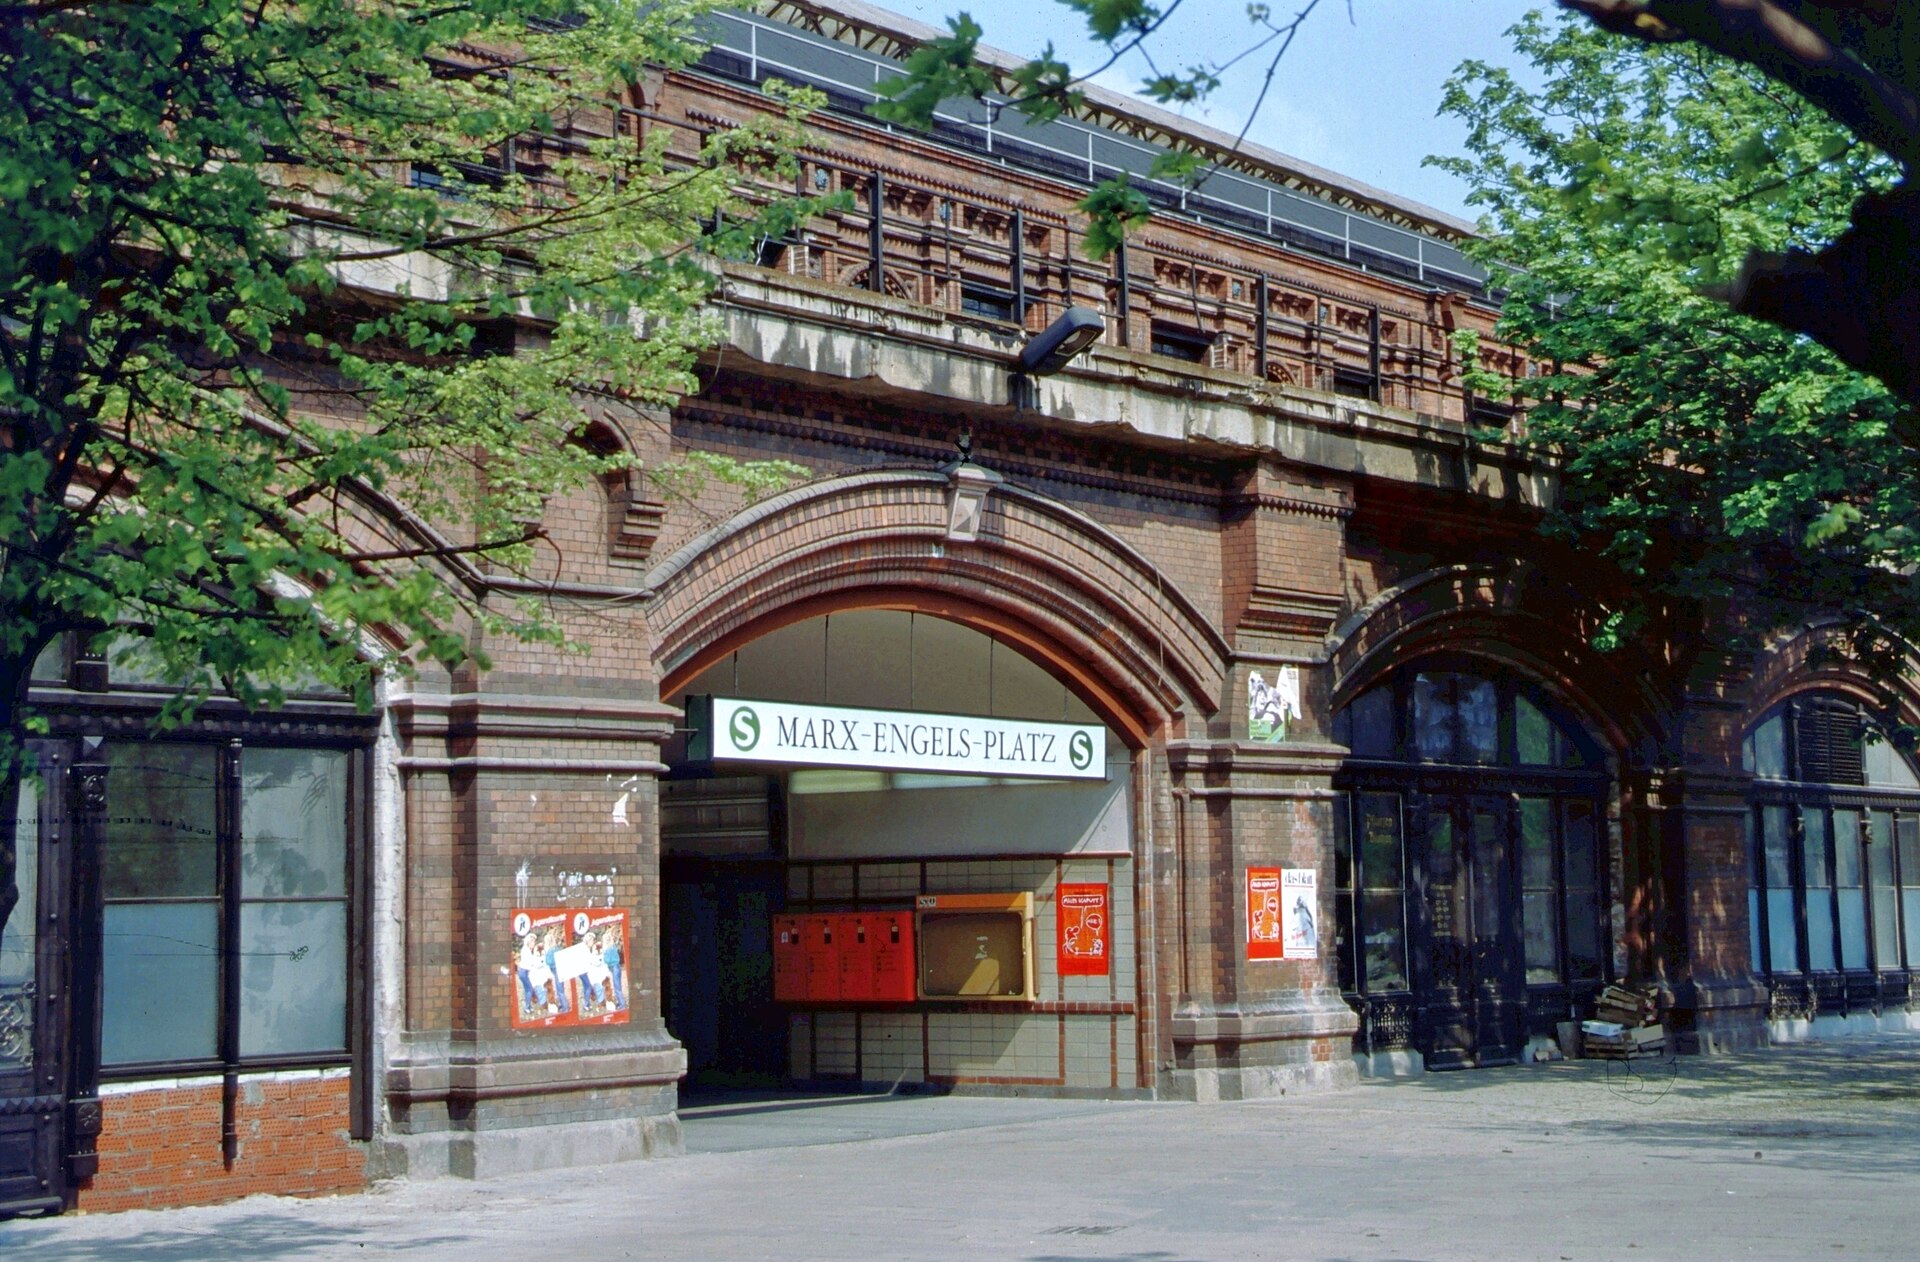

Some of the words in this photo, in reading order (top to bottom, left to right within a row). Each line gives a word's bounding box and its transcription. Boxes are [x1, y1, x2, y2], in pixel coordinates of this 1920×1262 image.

[730, 706, 760, 751] S
[777, 715, 1057, 763] MARX-ENGELS-PLATZ
[1069, 730, 1093, 770] S
